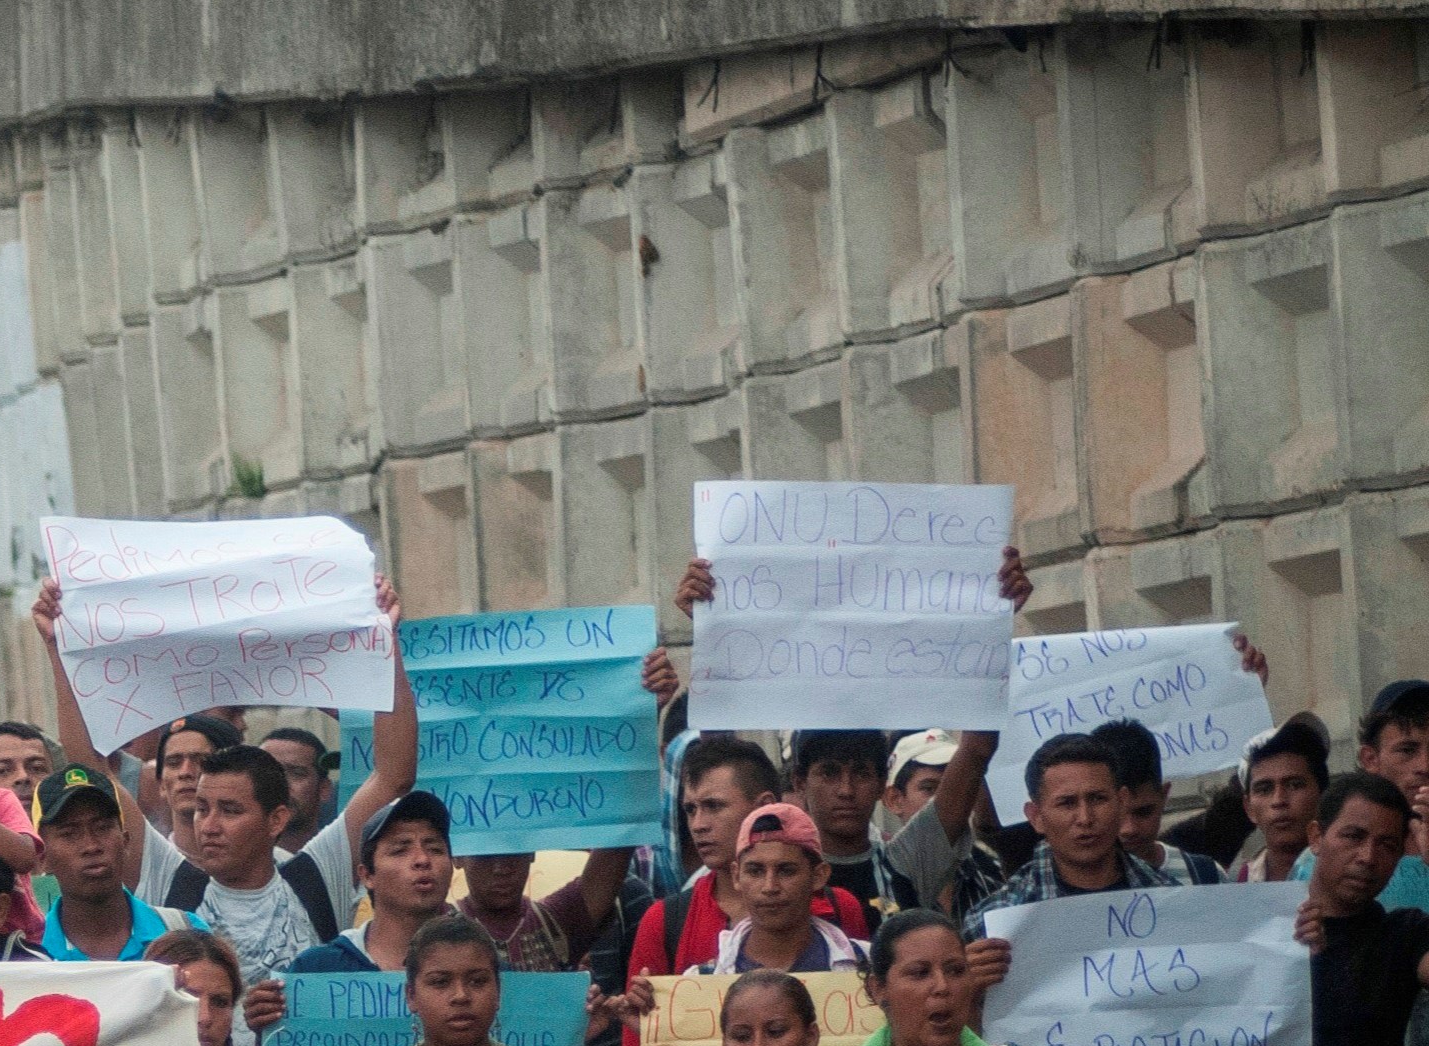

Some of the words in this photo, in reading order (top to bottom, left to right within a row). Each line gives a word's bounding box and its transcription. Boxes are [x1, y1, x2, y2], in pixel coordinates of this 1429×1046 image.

[566, 608, 614, 648] UN
[172, 657, 333, 711] FAVOR
[1108, 891, 1157, 939] NO
[1083, 948, 1201, 998] MAS
